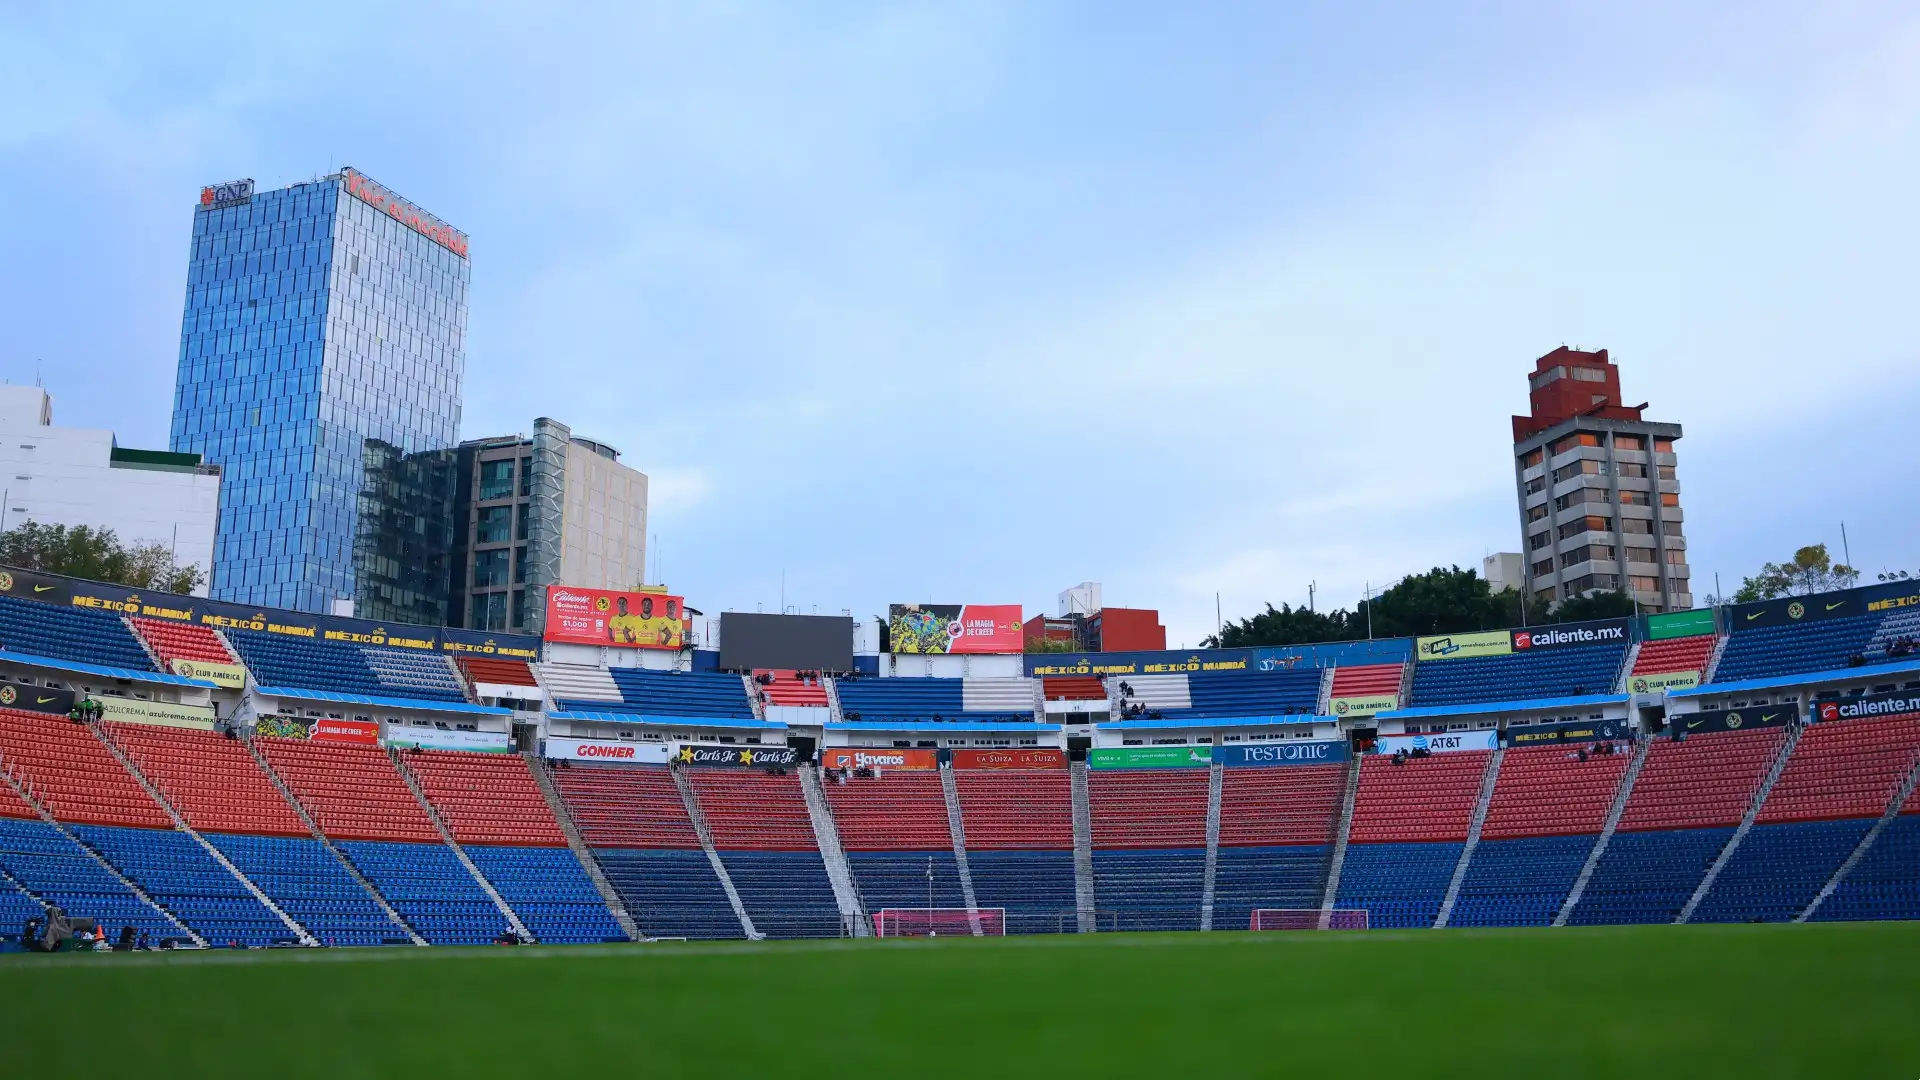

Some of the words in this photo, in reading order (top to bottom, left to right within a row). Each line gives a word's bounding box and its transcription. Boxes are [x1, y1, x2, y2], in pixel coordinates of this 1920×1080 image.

[215, 183, 248, 202] GNP
[72, 595, 139, 613] MÉXICO
[1867, 595, 1920, 611] MÉXIC
[201, 615, 264, 631] MÉXICO
[562, 620, 588, 628] $1,000
[966, 619, 976, 629] LA
[975, 619, 995, 629] MAGIA
[324, 630, 385, 645] MÉXICO
[966, 628, 975, 636] DE
[975, 628, 994, 637] CREER
[1531, 627, 1623, 647] caliente.mx
[443, 642, 495, 654] MÉXICO
[1034, 665, 1090, 675] MÉXICO
[1143, 663, 1200, 673] MÉXICO
[195, 669, 211, 677] CLUB
[212, 671, 240, 681] AMÉRICA
[1649, 680, 1665, 689] CLUB
[1665, 678, 1694, 687] AMÉRICA
[104, 704, 146, 716] AZULCREMA
[1365, 701, 1392, 710] AMÉRICA
[320, 725, 327, 733] LA
[1430, 737, 1462, 749] AT&T
[577, 745, 635, 759] GONHER
[693, 749, 720, 761] Carl's
[720, 750, 737, 763] Jr.
[753, 751, 780, 763] Carl's
[780, 751, 795, 763] Jr.
[1033, 754, 1057, 762] SUIZA
[989, 754, 1013, 763] SUIZA
